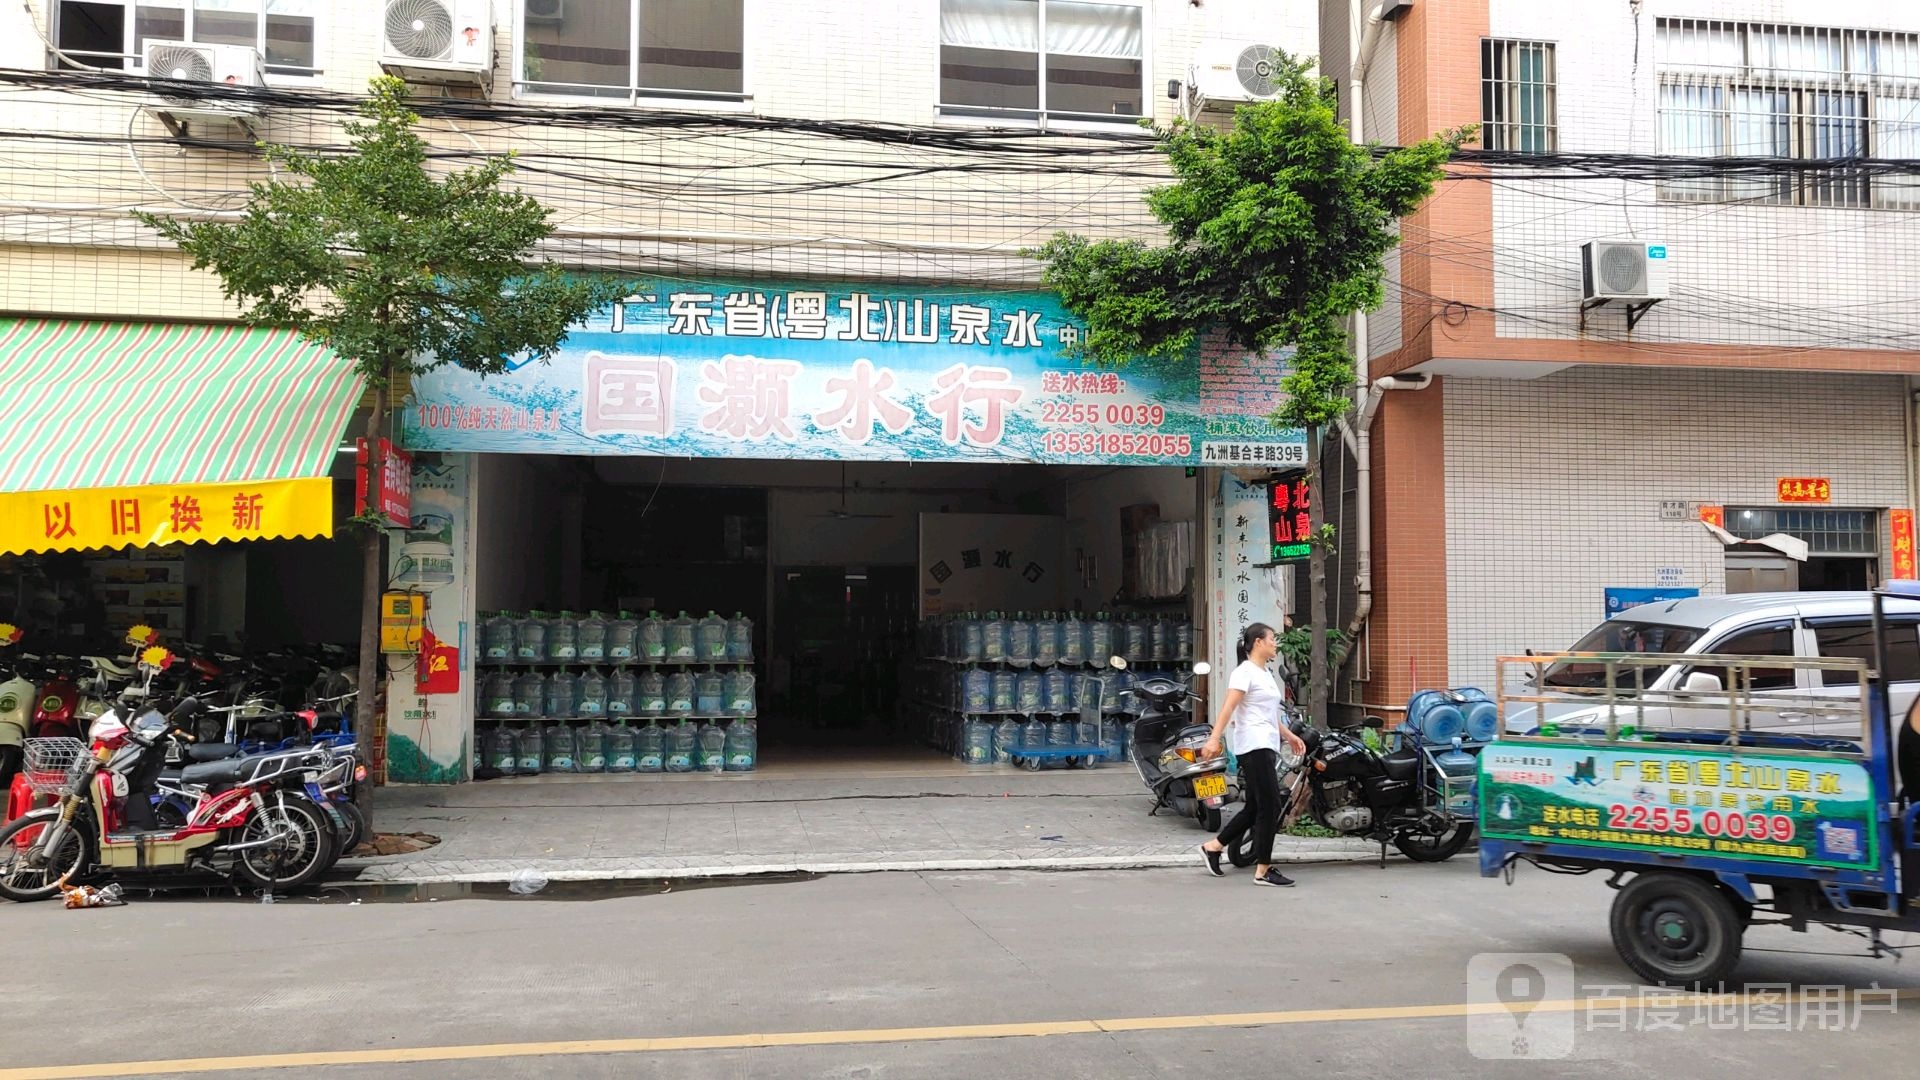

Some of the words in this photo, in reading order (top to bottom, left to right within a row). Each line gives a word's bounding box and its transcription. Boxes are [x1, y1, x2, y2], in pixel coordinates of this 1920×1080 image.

[583, 351, 1024, 445] 国灏水行
[417, 403, 561, 432] 100%纯天然山泉水
[1042, 403, 1099, 425] 2255
[1105, 404, 1164, 427] 0039
[1043, 433, 1192, 457] 13531852055
[1205, 444, 1303, 461] 九洲基合丰路39号
[1275, 482, 1310, 512] 粤北
[44, 492, 264, 540] 以旧换新
[1275, 513, 1311, 543] 山泉
[1608, 803, 1694, 834] 2255
[1702, 810, 1795, 842] 0039
